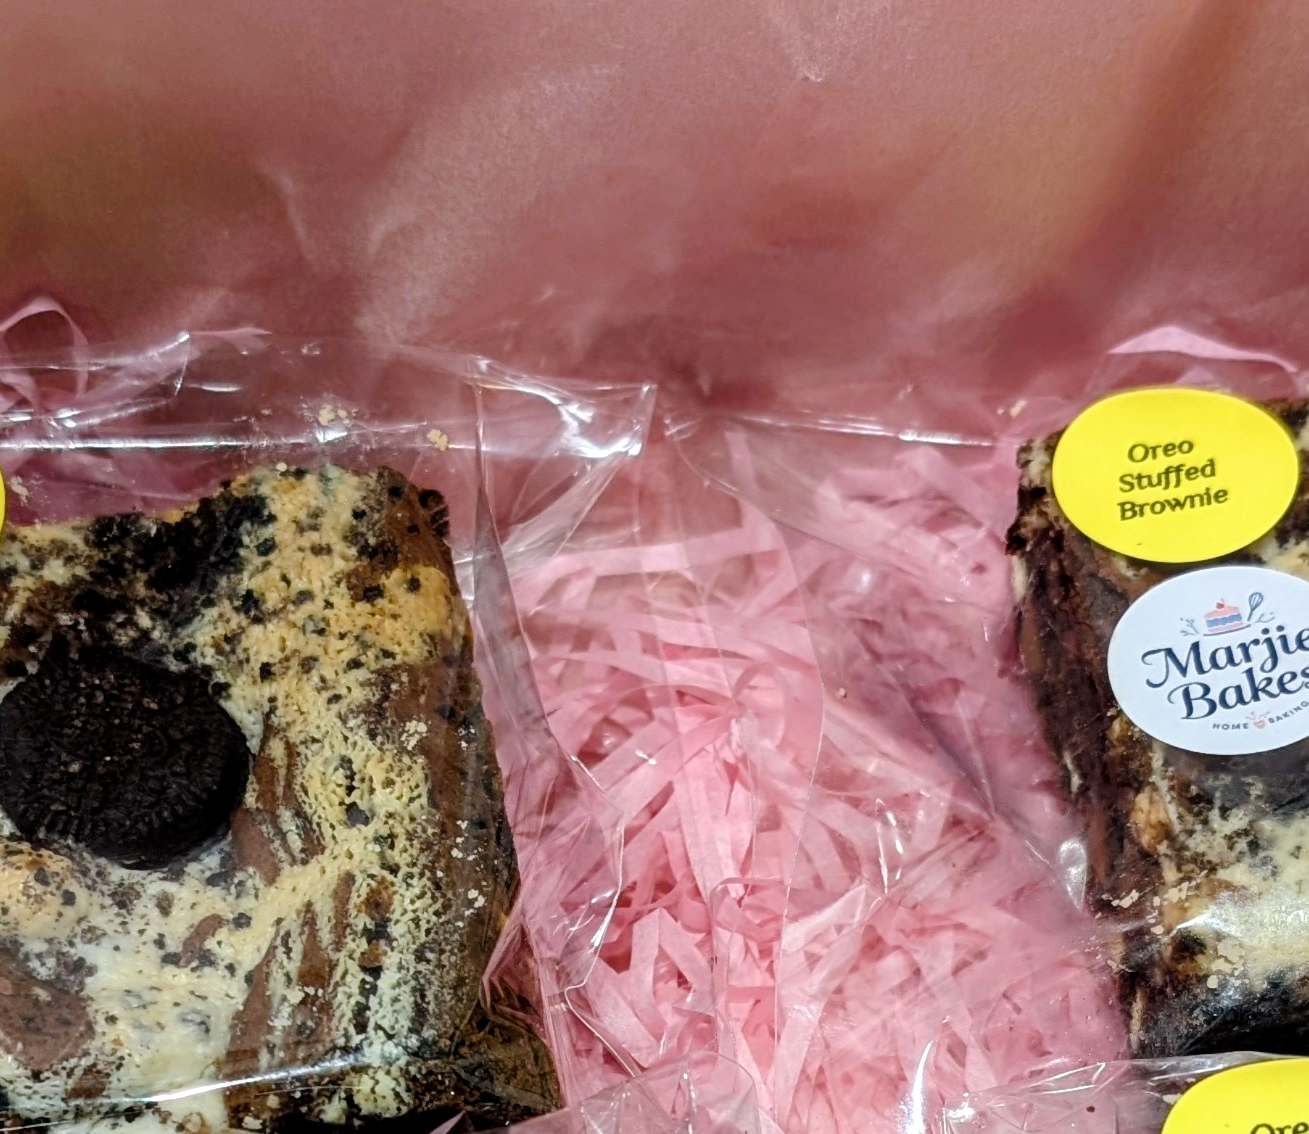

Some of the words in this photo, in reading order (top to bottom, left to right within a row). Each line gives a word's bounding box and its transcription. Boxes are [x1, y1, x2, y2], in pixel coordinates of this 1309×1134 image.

[1127, 440, 1194, 463] Oreo
[1118, 458, 1216, 493] Stuffed
[1116, 487, 1229, 521] Brownie
[1211, 722, 1250, 731] HOME
[1268, 700, 1309, 725] BAKING
